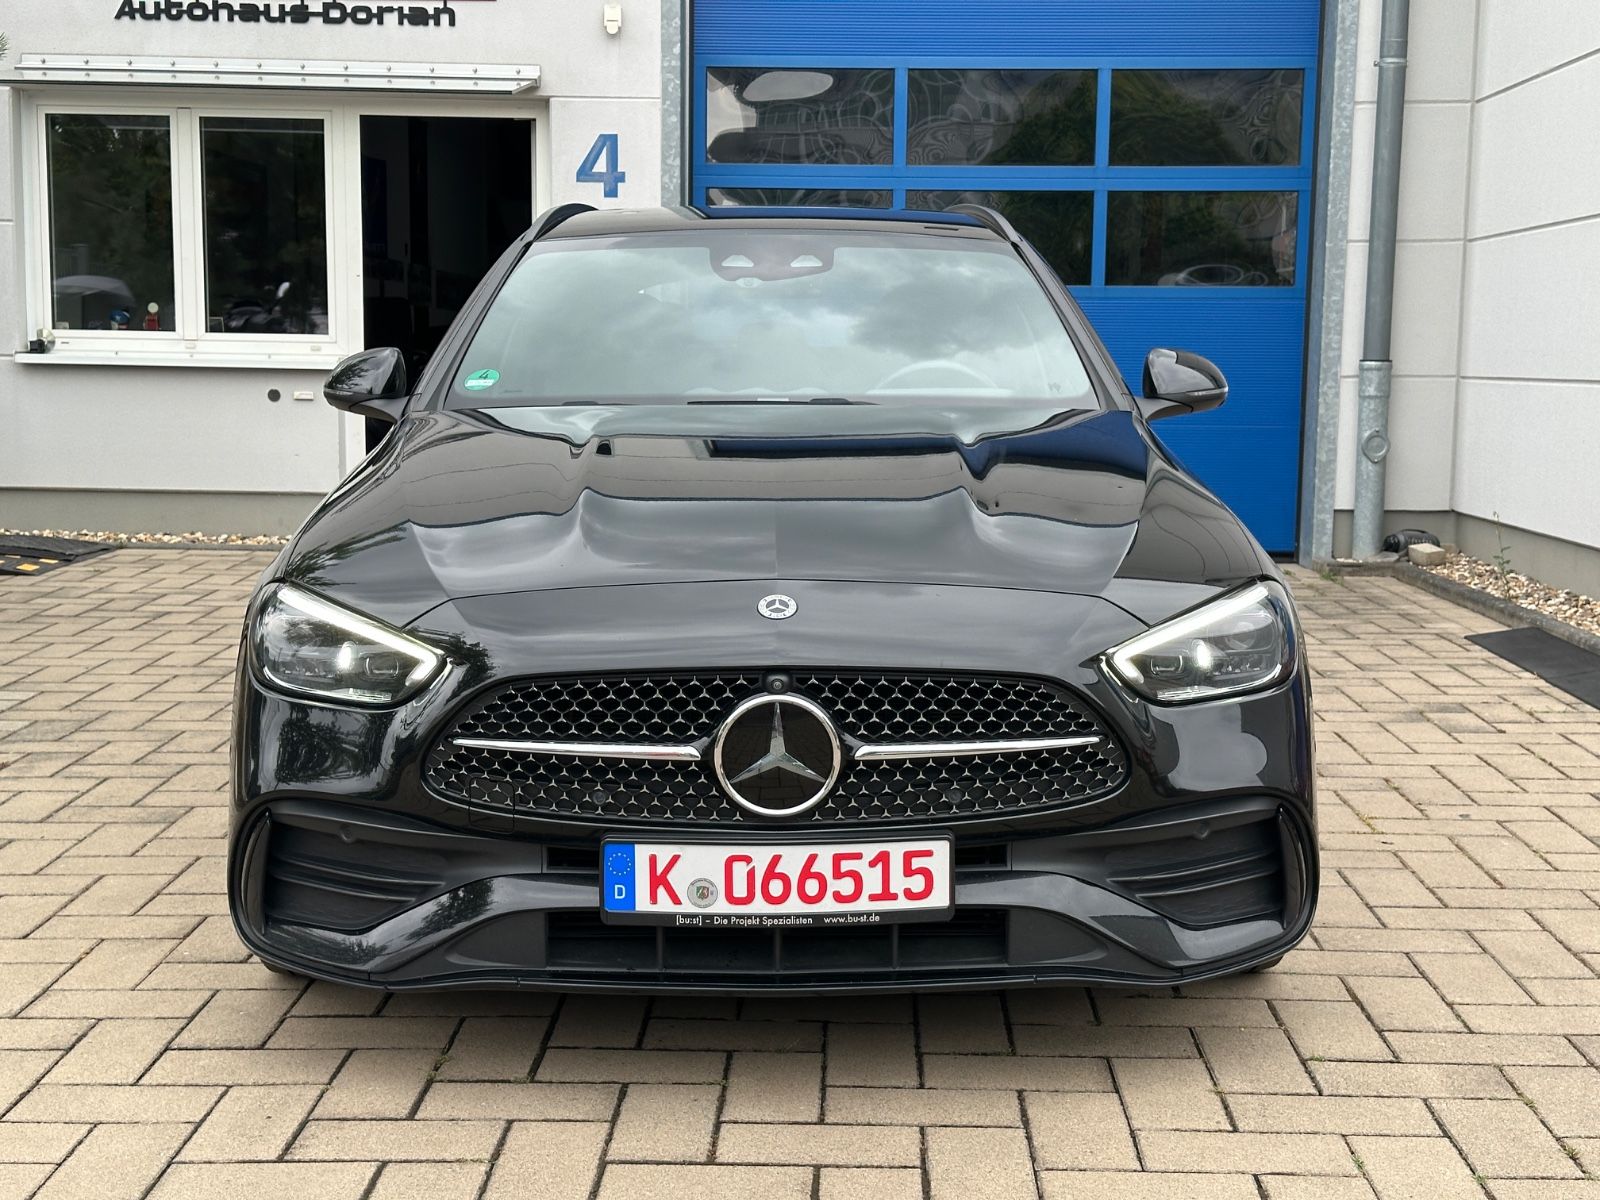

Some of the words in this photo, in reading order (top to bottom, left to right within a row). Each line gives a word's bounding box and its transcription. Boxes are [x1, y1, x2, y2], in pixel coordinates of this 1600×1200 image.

[114, 0, 309, 24] Autohaus
[322, 0, 456, 27] Dorian
[576, 134, 625, 198] 4
[480, 369, 490, 379] 4
[649, 854, 683, 906] K
[724, 849, 935, 906] 066515
[614, 885, 626, 900] D
[713, 916, 728, 925] Die
[730, 916, 760, 927] Projekt
[762, 916, 813, 926] Spezialisten
[823, 913, 880, 923] www.bu-st.de
